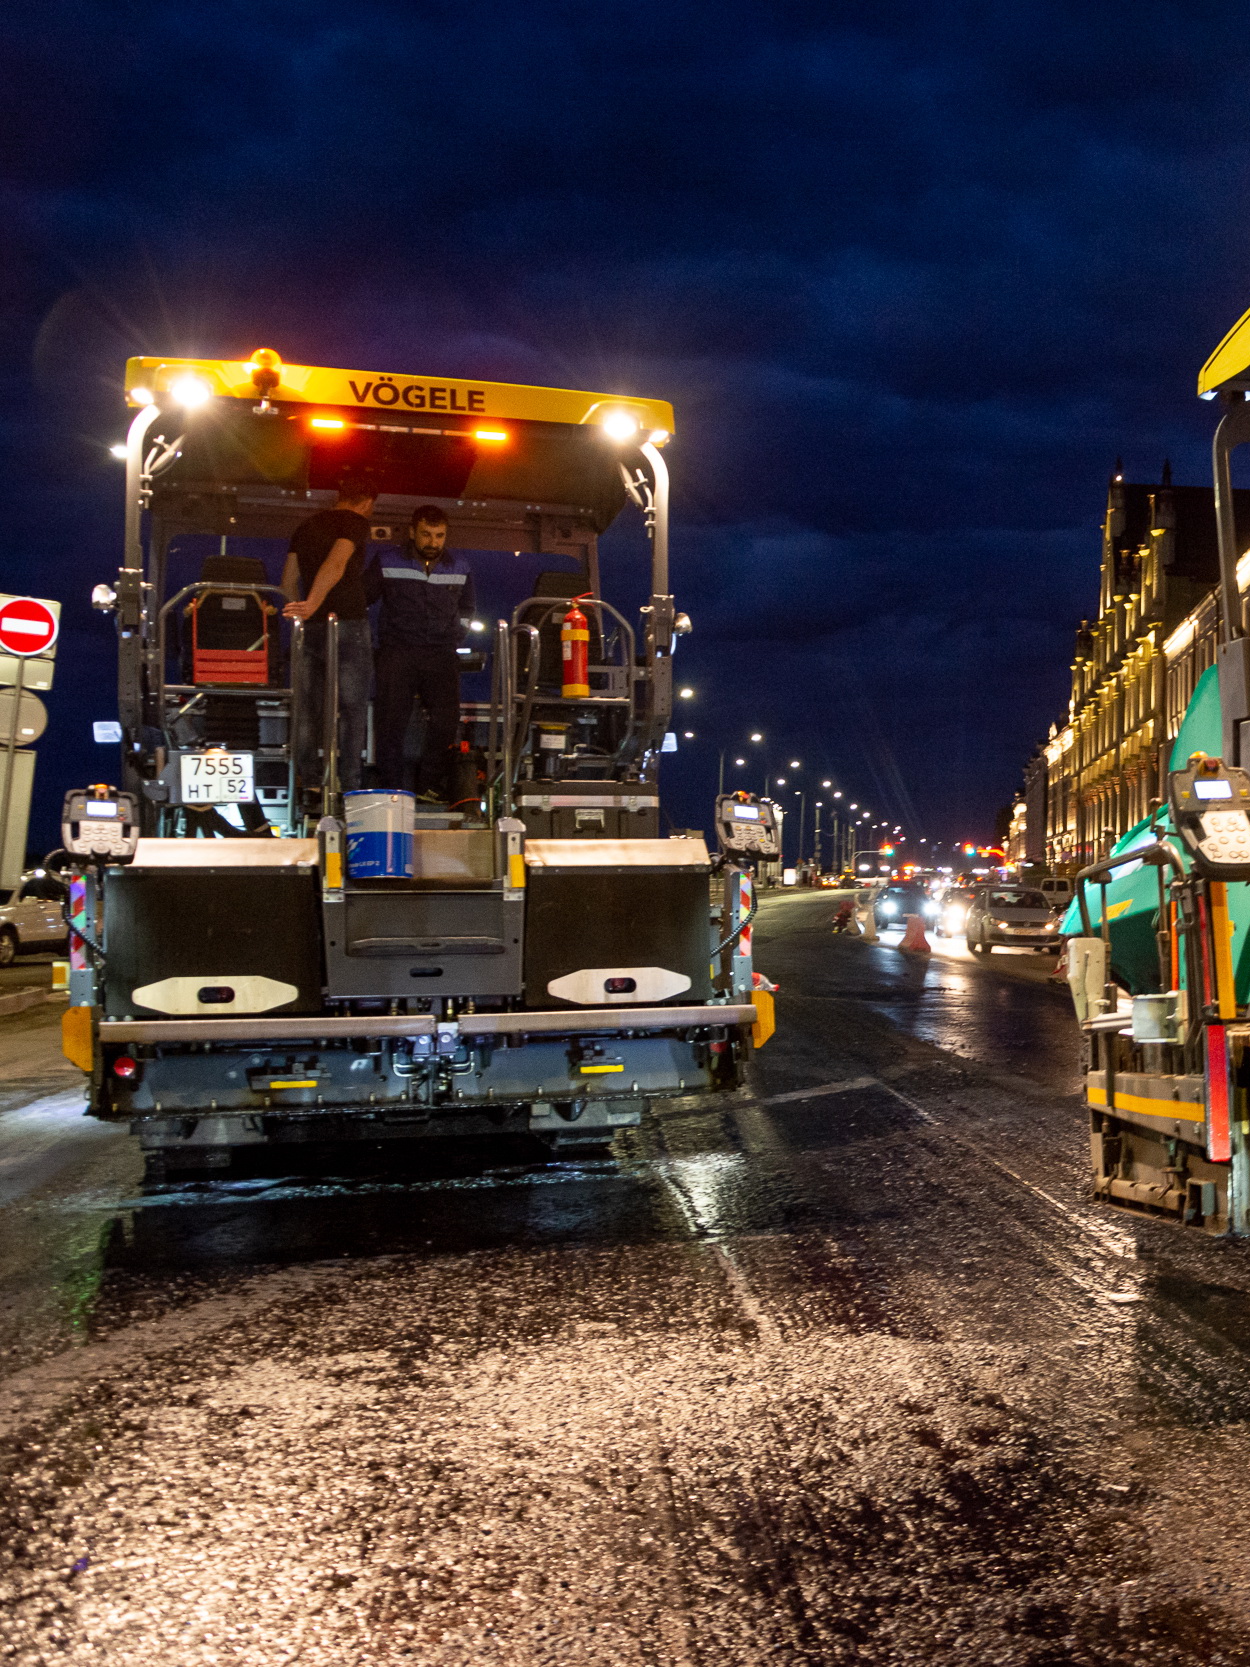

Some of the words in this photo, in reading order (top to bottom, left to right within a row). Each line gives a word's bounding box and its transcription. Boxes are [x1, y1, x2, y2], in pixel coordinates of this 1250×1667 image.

[348, 376, 486, 413] VÖGELE
[191, 757, 243, 776] 7555
[227, 779, 247, 793] 52
